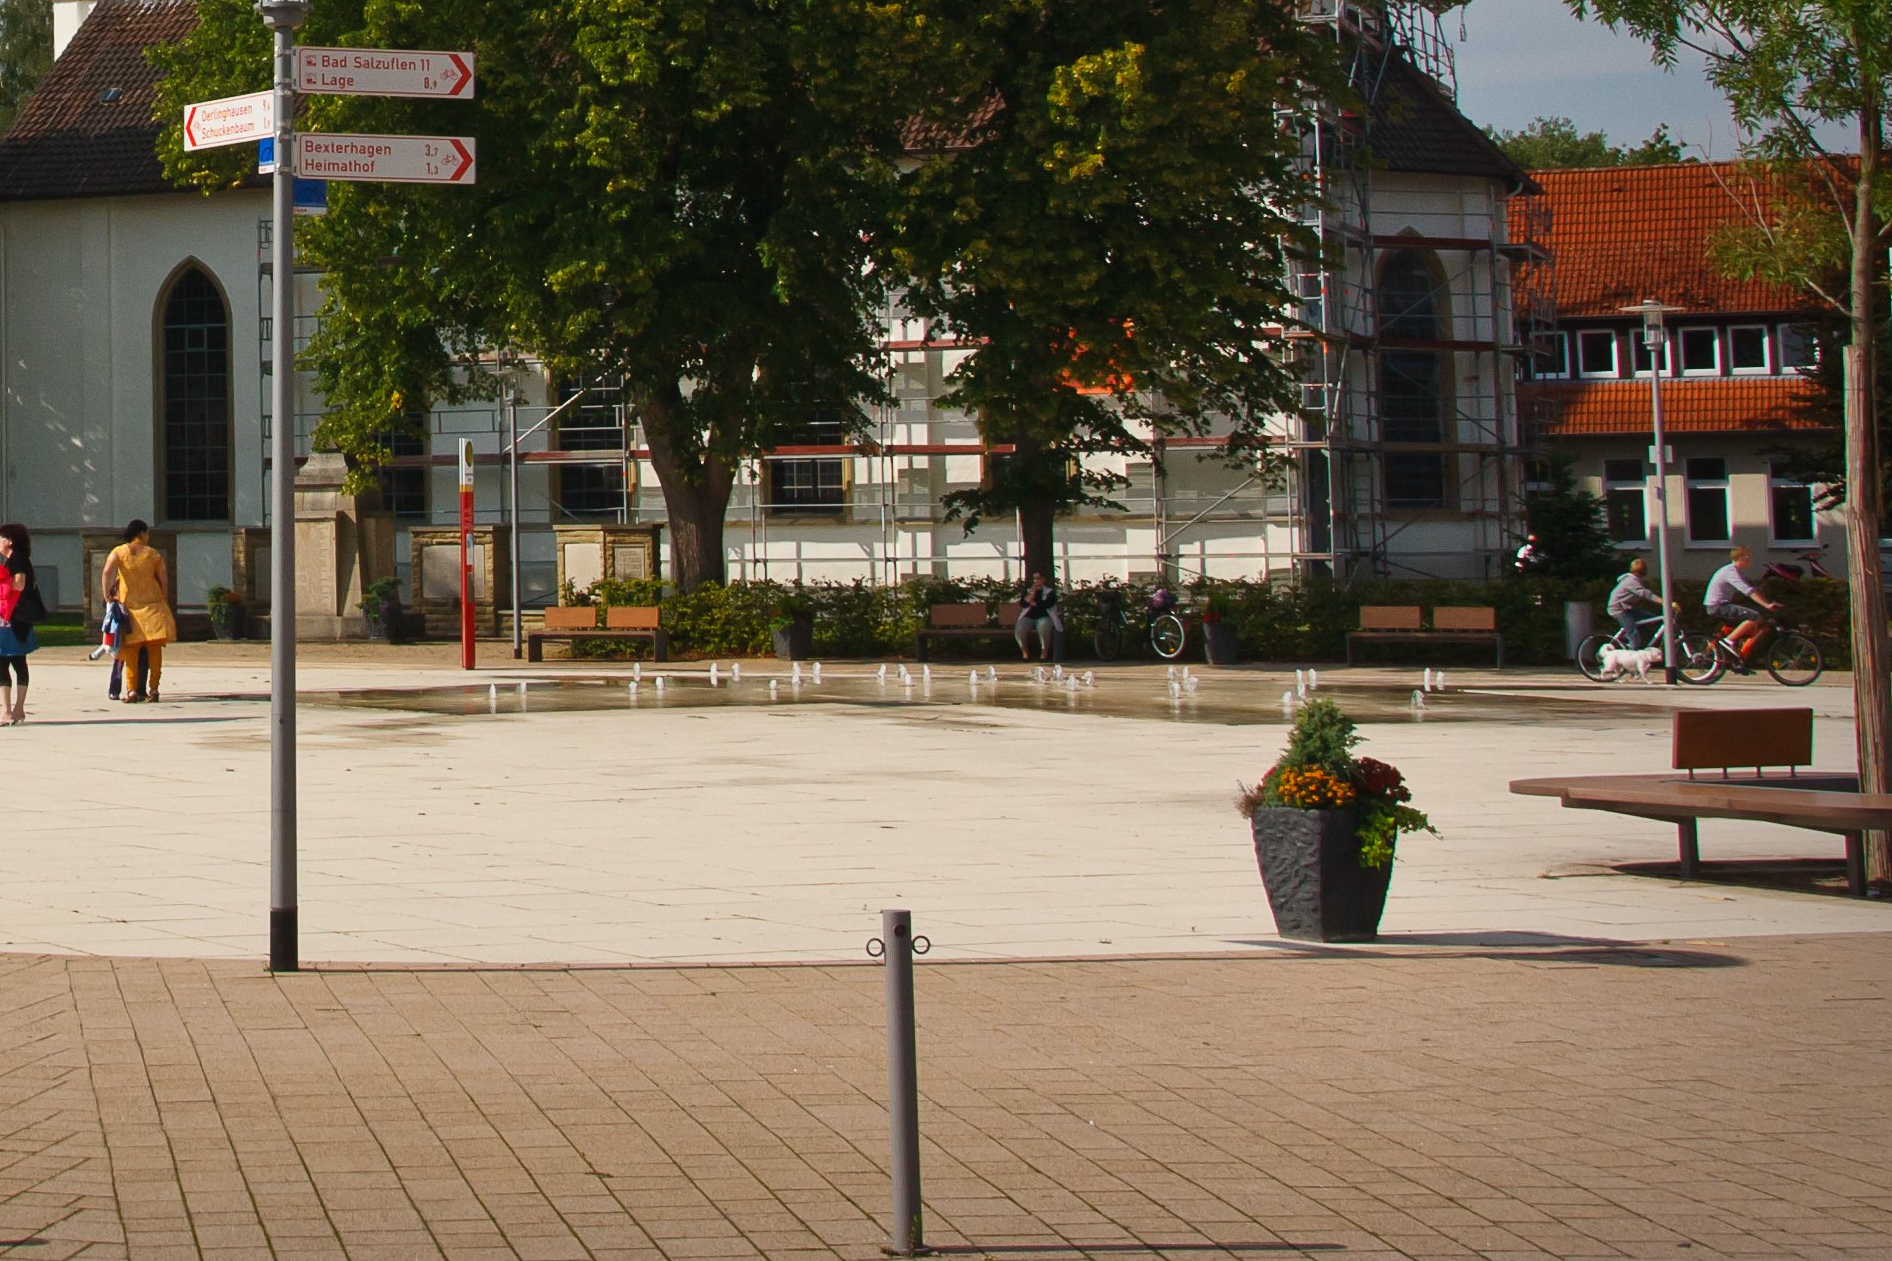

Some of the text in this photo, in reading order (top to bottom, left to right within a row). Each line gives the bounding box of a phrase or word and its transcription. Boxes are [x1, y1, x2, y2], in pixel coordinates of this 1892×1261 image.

[321, 55, 430, 71] Bad Salzuflen 11
[321, 73, 355, 89] Lage
[201, 105, 253, 122] Oerlinghausen
[201, 122, 255, 140] Schuckenbaum
[305, 140, 392, 157] Bexterhagen
[305, 159, 375, 173] Heimathof
